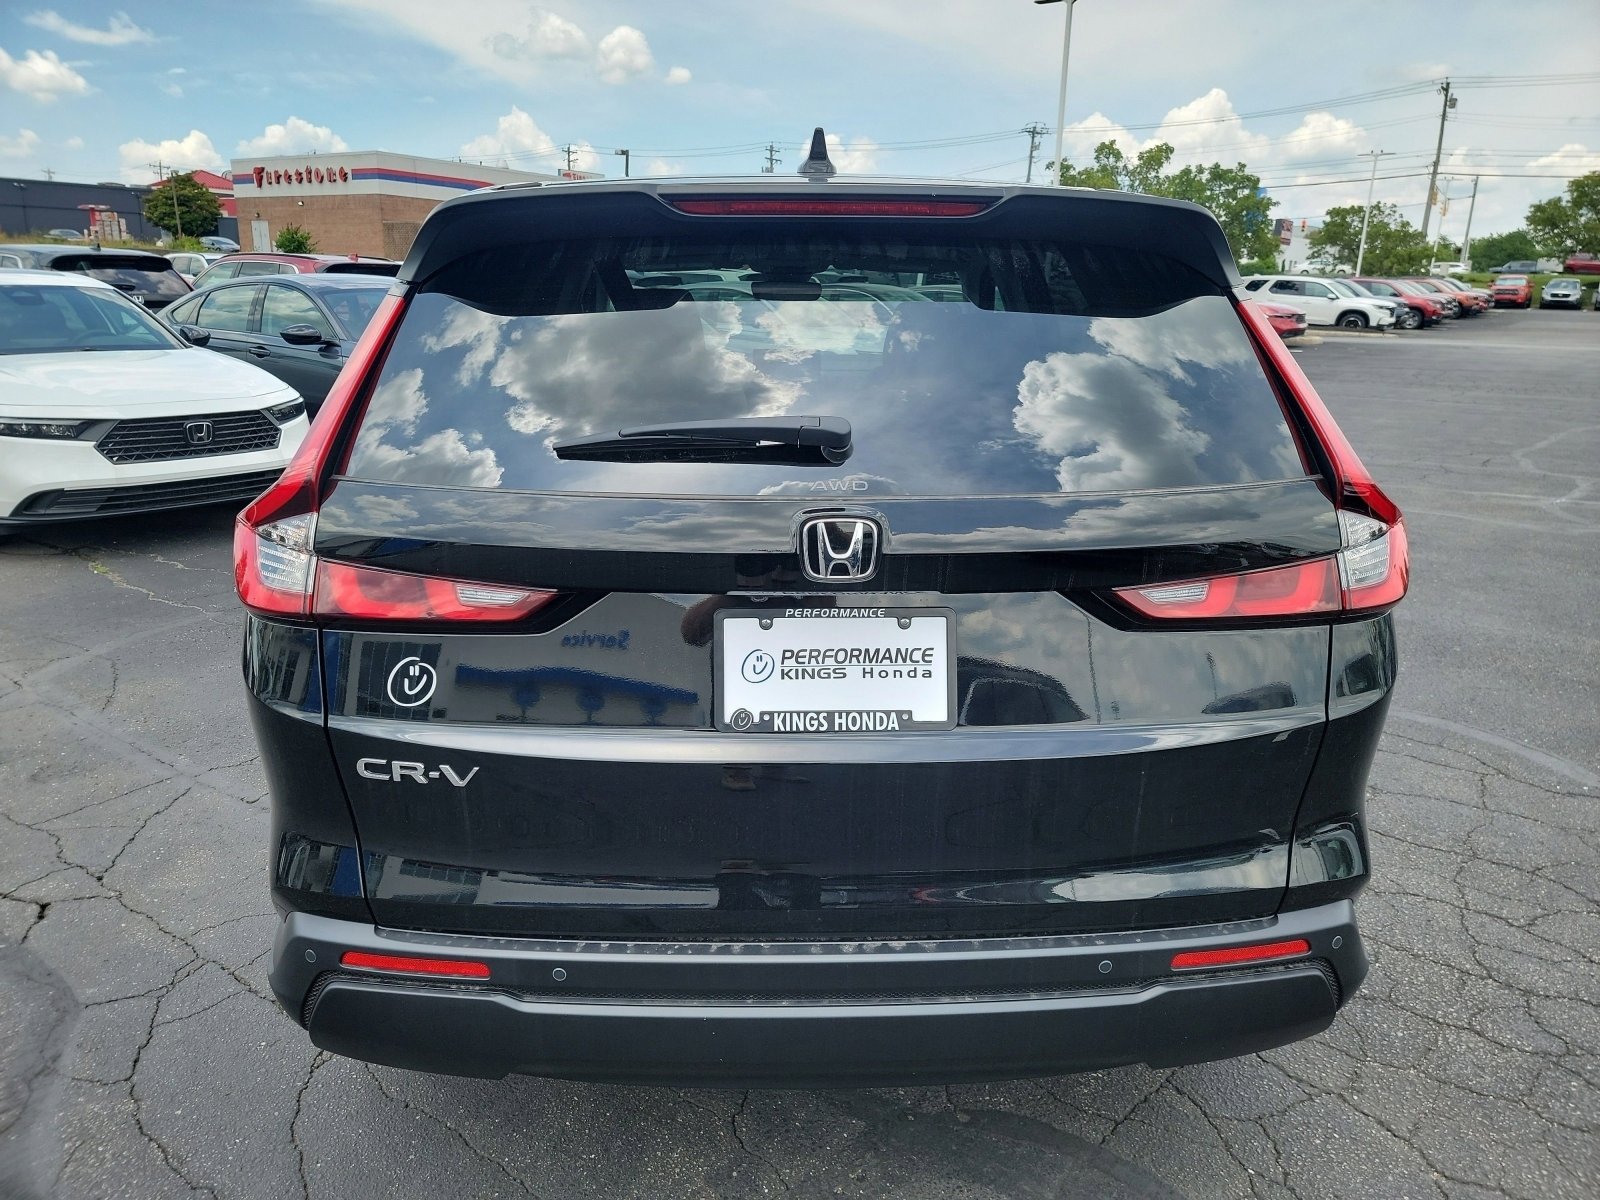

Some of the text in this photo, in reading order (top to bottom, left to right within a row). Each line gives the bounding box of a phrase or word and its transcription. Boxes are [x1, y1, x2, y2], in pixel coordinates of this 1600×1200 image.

[253, 166, 348, 188] Firestone
[810, 480, 869, 491] AWD
[785, 608, 886, 618] PERFORMANCE
[781, 648, 934, 665] PERFORMANCE
[780, 667, 933, 680] KINGS Honda
[773, 711, 900, 732] KINGS HONDA
[356, 757, 480, 788] CR-V
